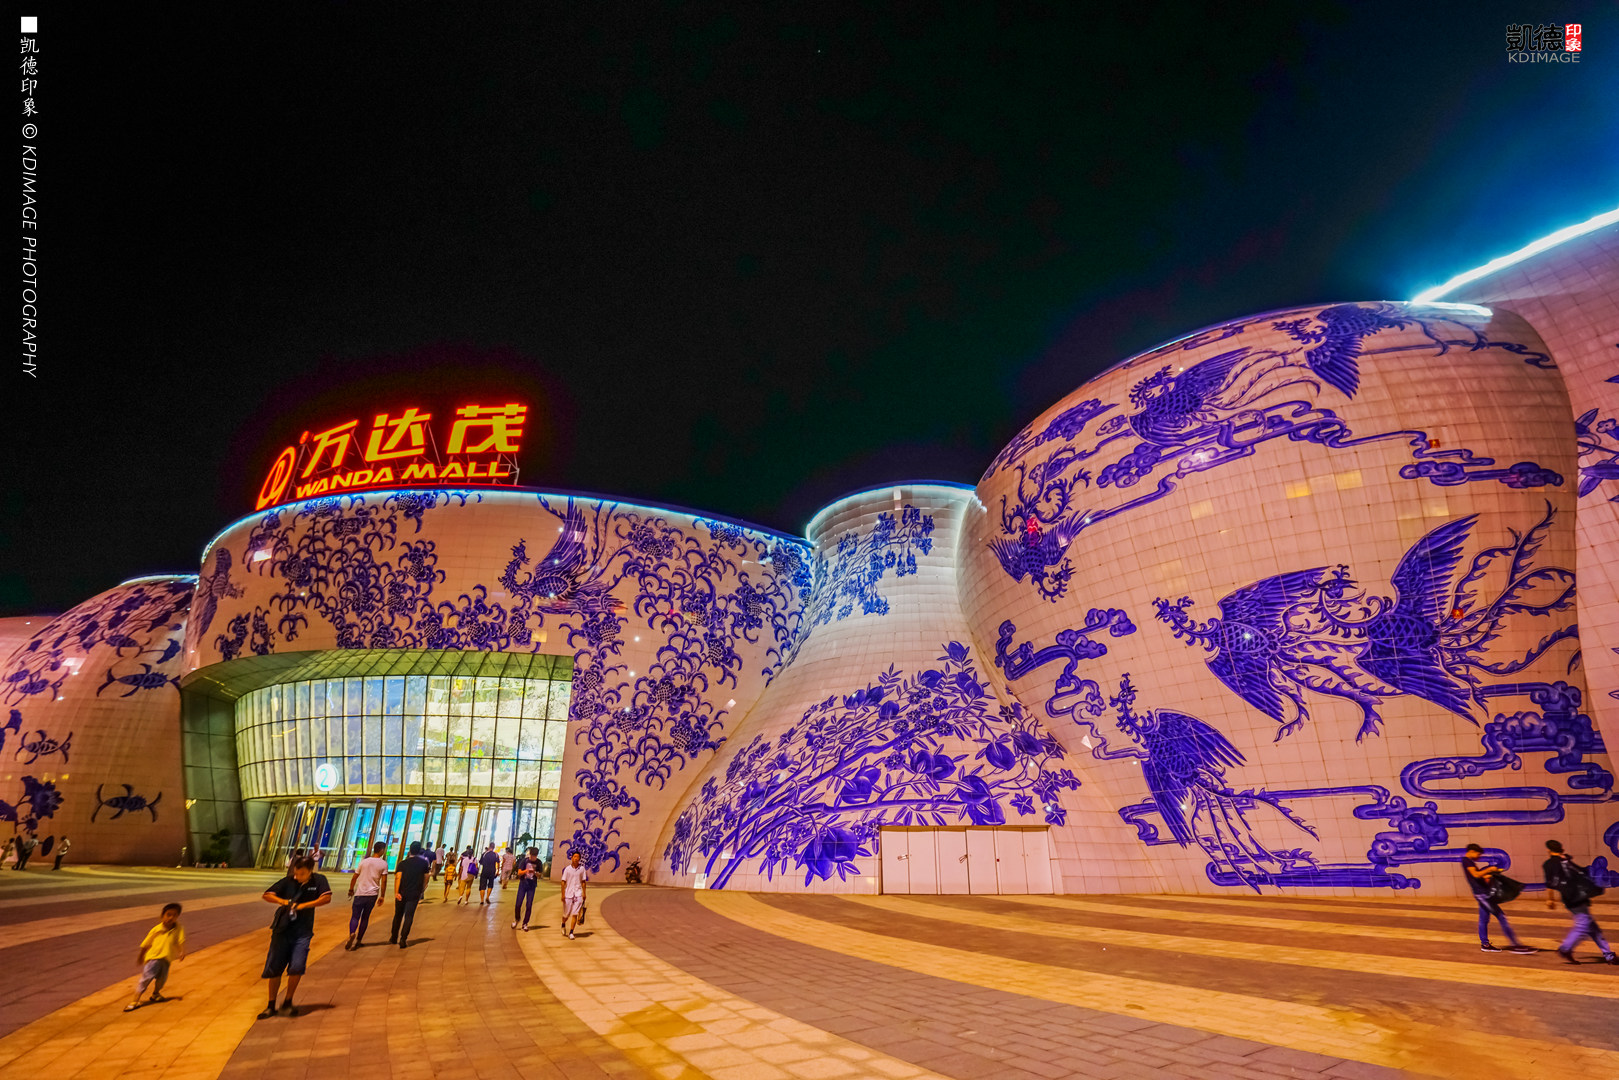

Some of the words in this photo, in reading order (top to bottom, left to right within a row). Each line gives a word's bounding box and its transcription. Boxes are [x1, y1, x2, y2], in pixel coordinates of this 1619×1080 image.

[301, 403, 528, 479] 万达茂
[295, 466, 395, 499] WANDA
[400, 461, 510, 480] MALL
[319, 768, 329, 788] 2
